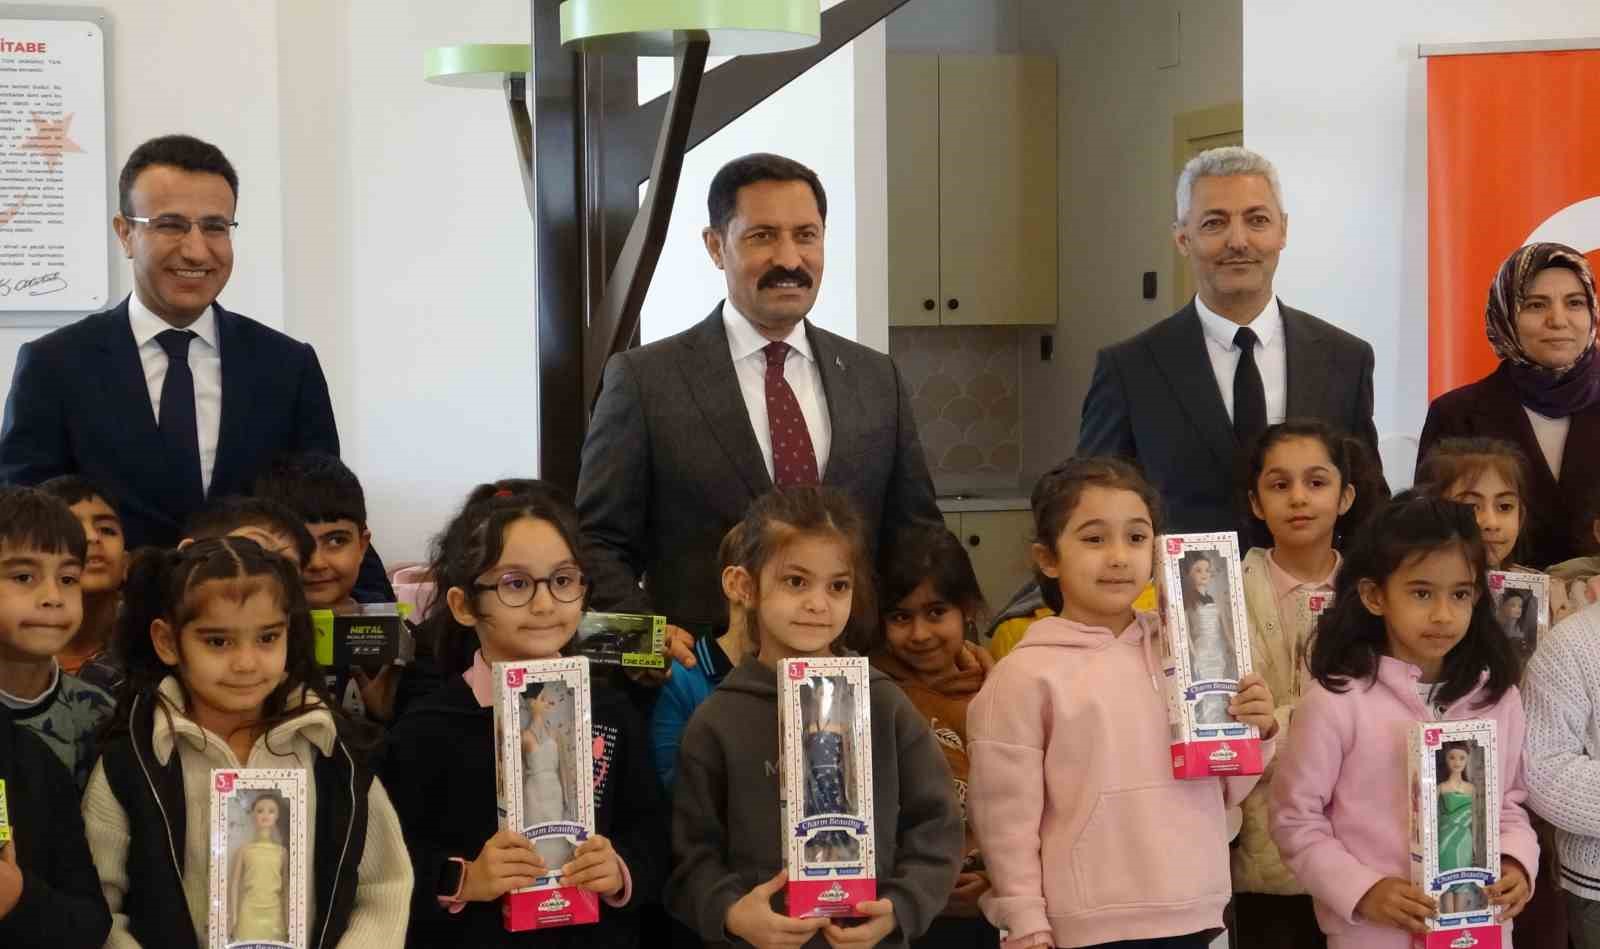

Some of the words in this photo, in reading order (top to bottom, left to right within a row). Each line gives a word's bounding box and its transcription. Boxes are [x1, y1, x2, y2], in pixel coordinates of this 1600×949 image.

[350, 625, 384, 634] METAL
[802, 818, 828, 830] Charm
[526, 826, 547, 838] harm
